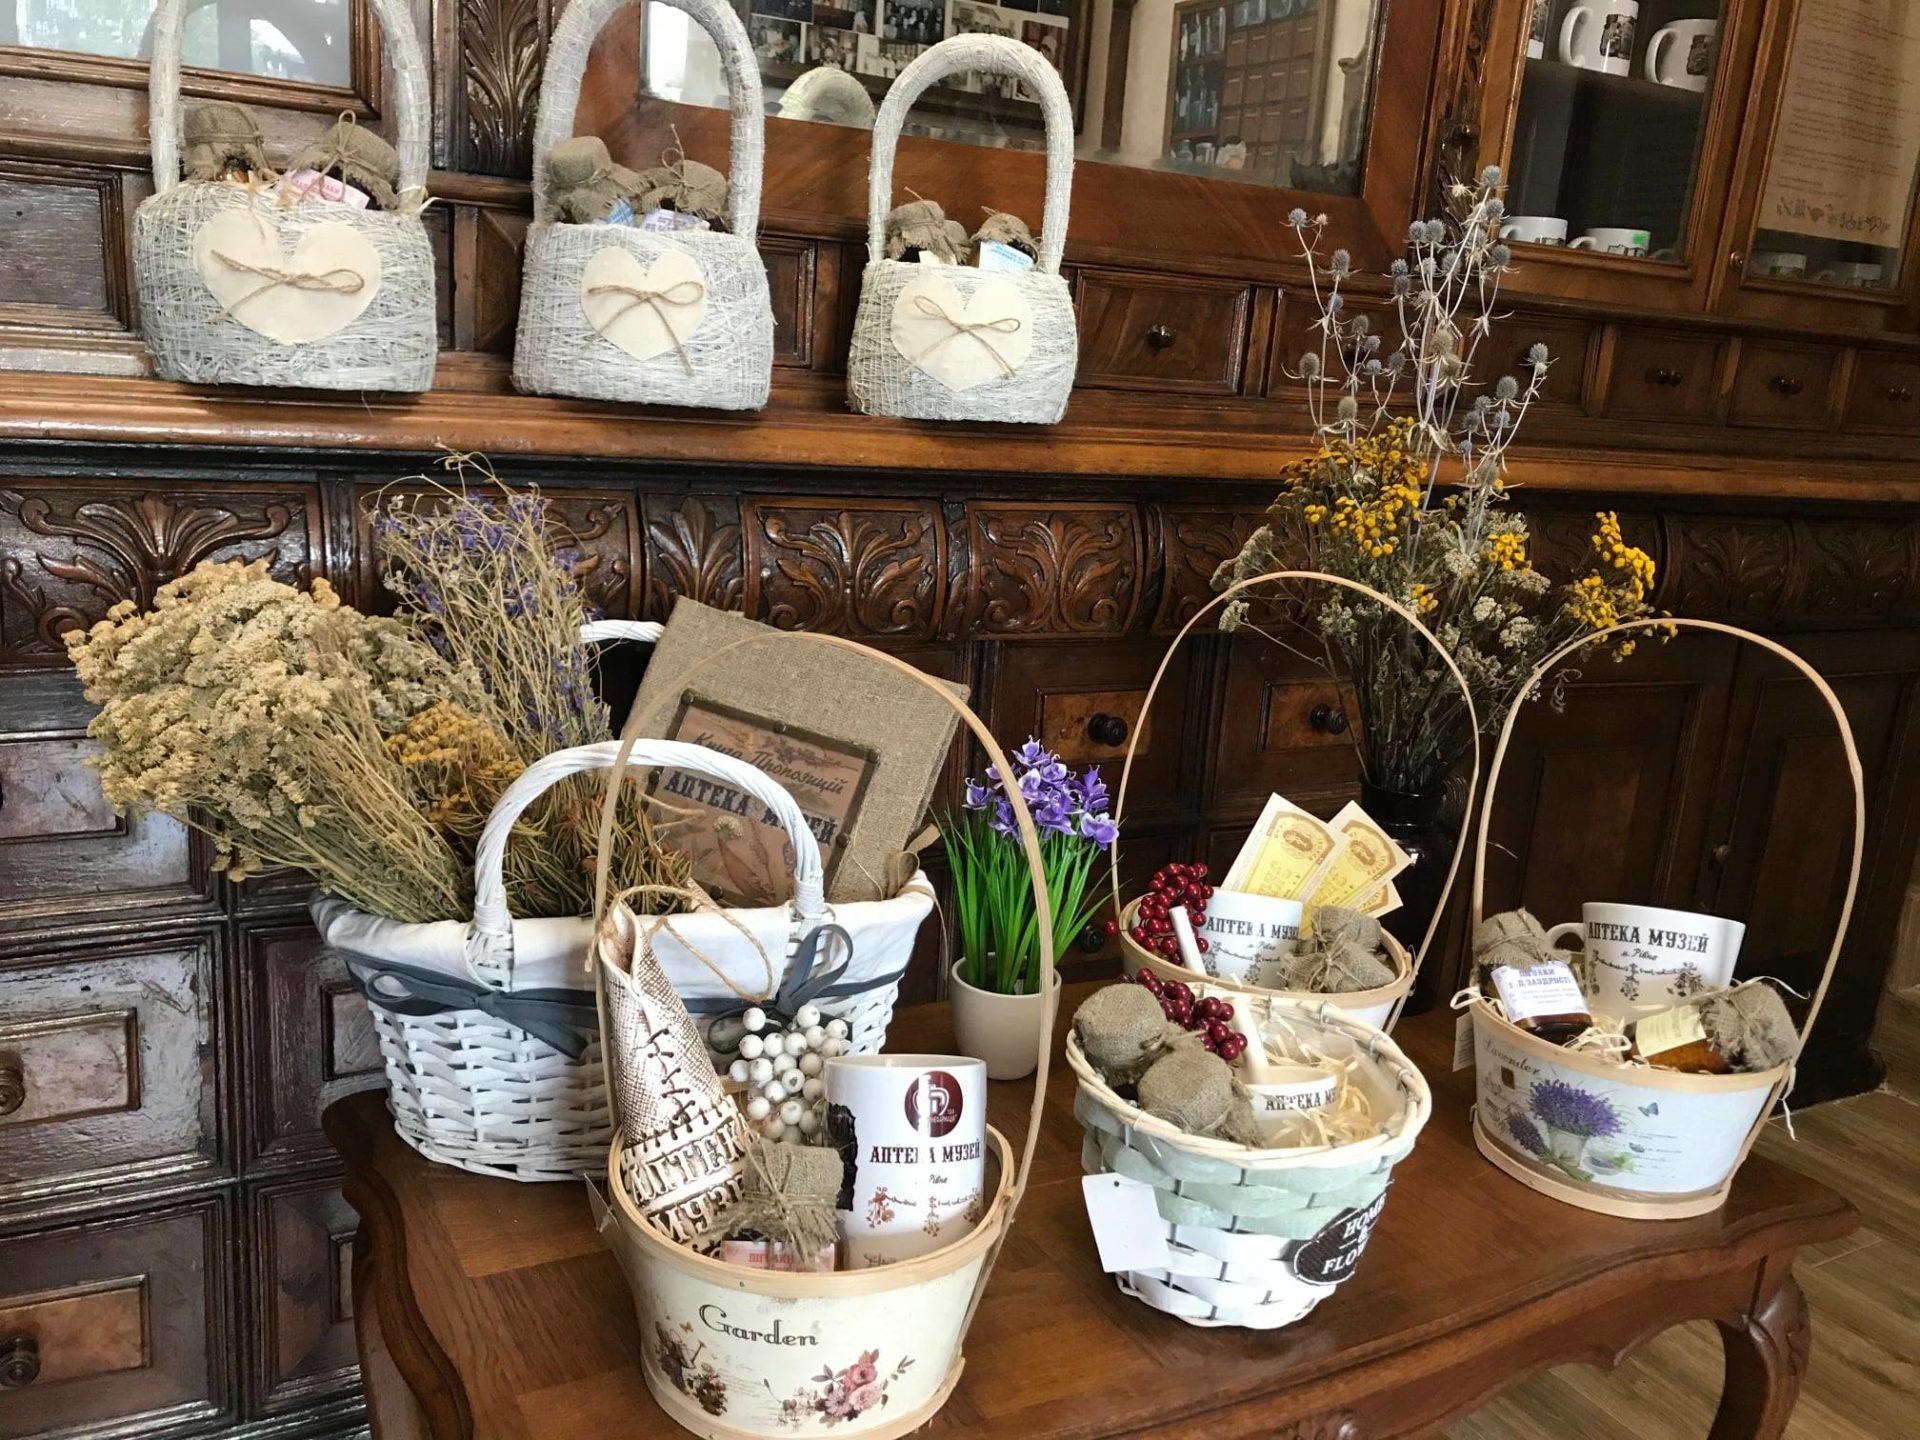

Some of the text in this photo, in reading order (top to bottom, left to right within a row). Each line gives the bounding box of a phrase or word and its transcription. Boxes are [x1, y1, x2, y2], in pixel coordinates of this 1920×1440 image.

[664, 770, 751, 816] АПТЕКА
[1588, 921, 1710, 954] АПТЕКА МУЗЕЙ
[941, 1138, 981, 1163] МУЗЕЙ
[699, 1304, 819, 1347] Garden
